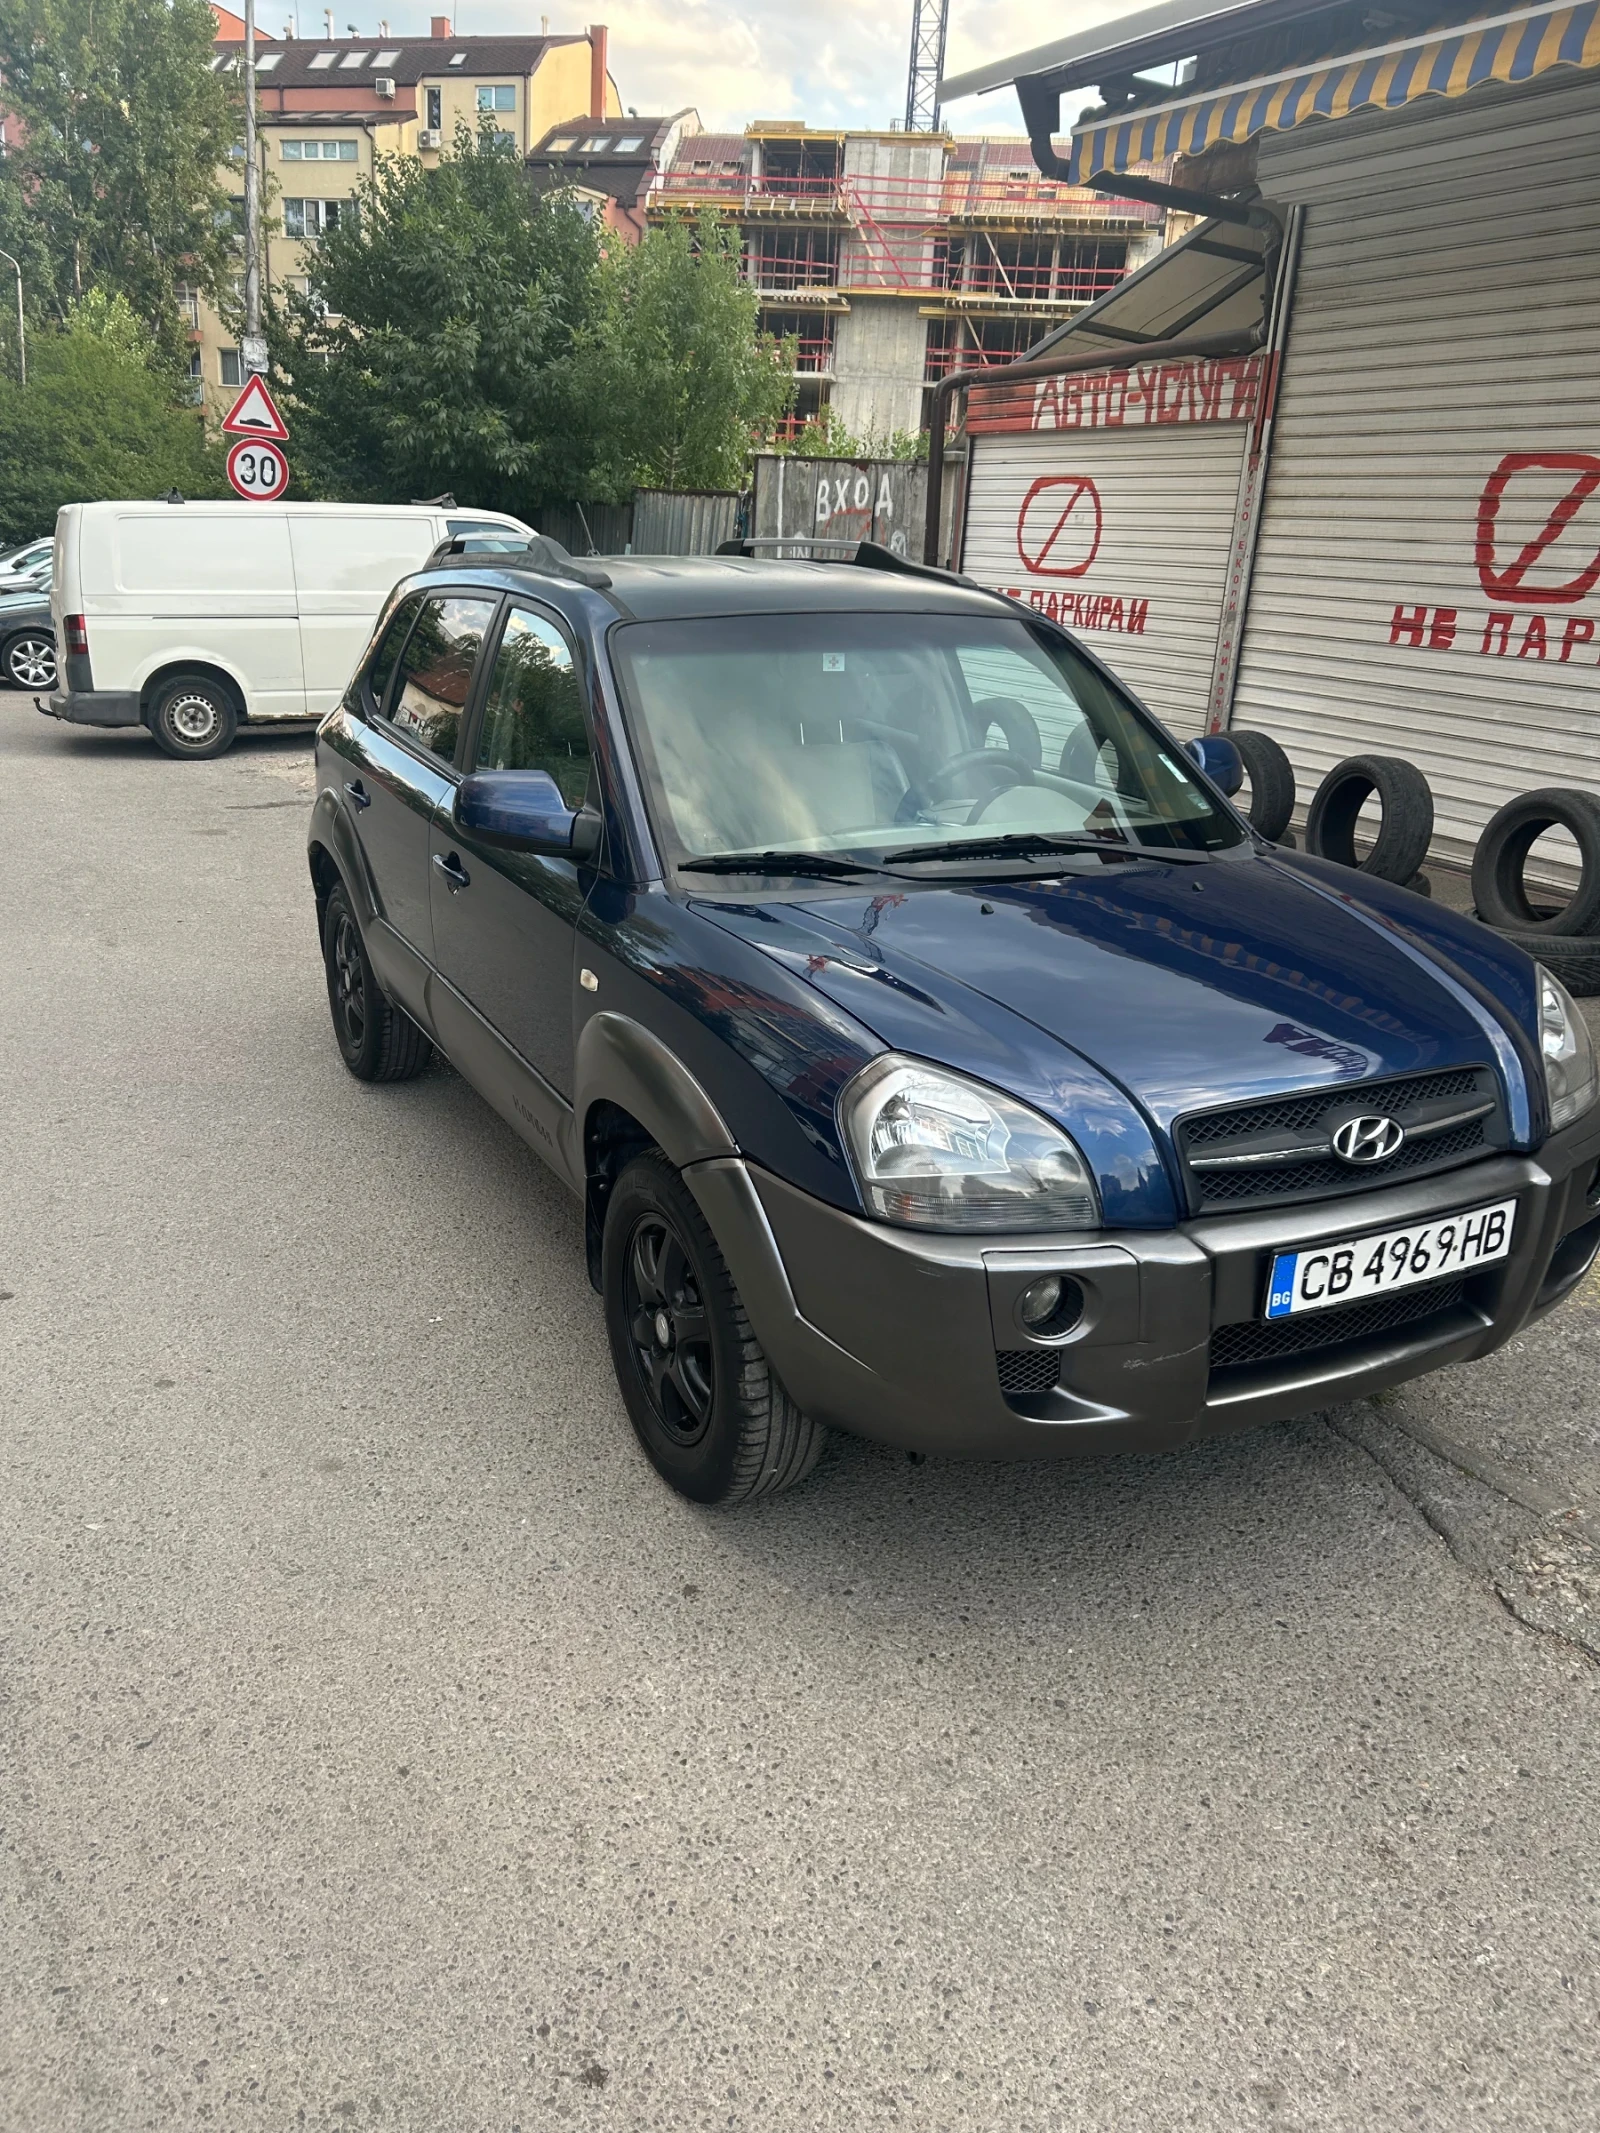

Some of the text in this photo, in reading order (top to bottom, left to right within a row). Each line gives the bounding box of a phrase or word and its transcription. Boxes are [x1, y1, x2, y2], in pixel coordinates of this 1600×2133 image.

[240, 453, 276, 488] 30
[816, 472, 893, 522] ВХОД
[1389, 605, 1600, 665] НЕ ПАР
[1271, 1209, 1507, 1307] BG CB 4969 HB
